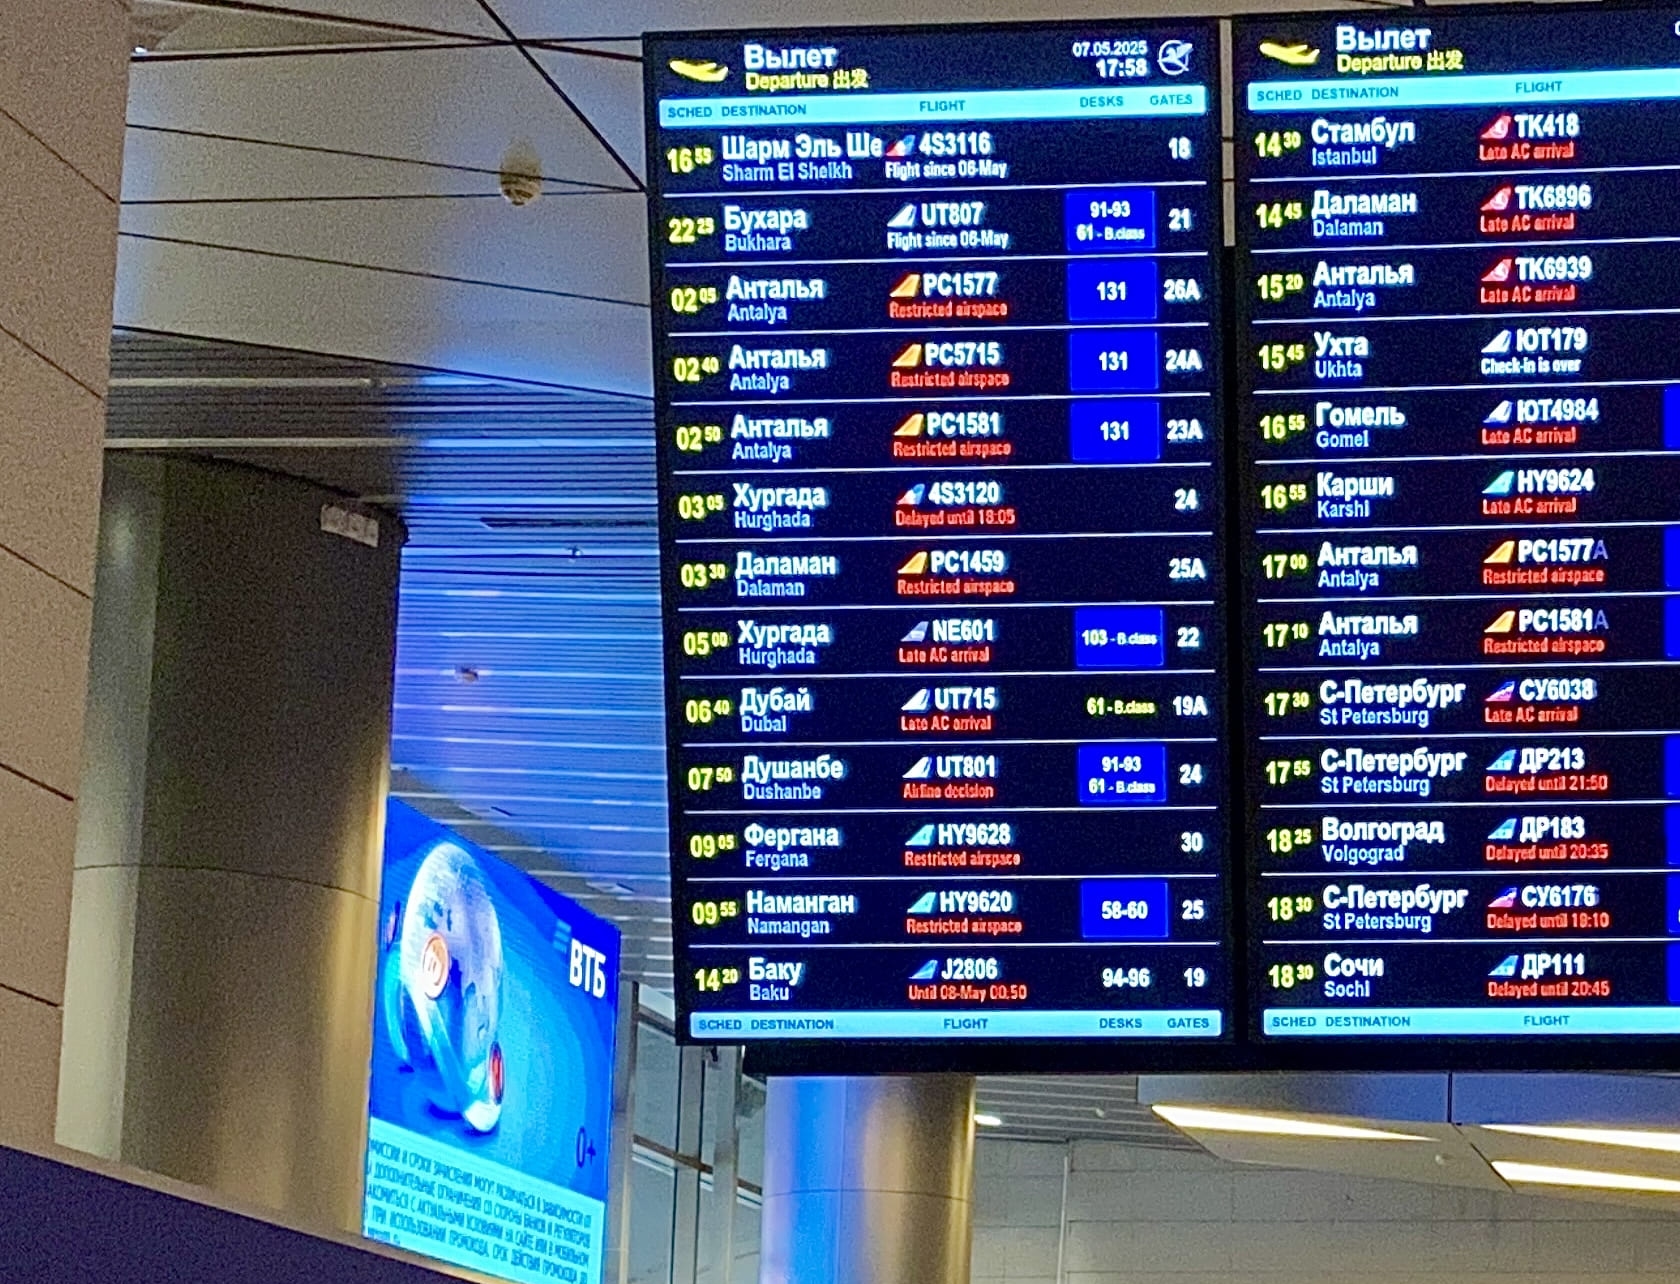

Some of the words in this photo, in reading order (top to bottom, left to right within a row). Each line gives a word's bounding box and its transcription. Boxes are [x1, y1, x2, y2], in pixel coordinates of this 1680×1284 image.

[744, 44, 836, 70] Вылет
[1072, 41, 1148, 57] 07.05.2025
[1097, 58, 1148, 77] 17:58
[746, 73, 828, 90] Departure
[833, 71, 868, 88] 出发
[668, 106, 712, 118] SCHED
[722, 104, 806, 117] DESTINATION
[920, 101, 965, 112] FLIGHT
[1079, 95, 1123, 108] DESKS
[1150, 94, 1193, 106] GATES
[1311, 119, 1415, 145] Стамбул
[1515, 114, 1578, 138] TK418
[722, 137, 788, 161] Шарм
[795, 135, 840, 157] Эль
[846, 133, 882, 156] Ше
[919, 133, 991, 155] 4S3116
[1170, 138, 1190, 158] 18
[1312, 146, 1377, 166] Istanbul
[723, 163, 771, 182] Sharm
[778, 163, 792, 179] El
[798, 162, 852, 180] Sheikh
[724, 207, 807, 235] Бухара
[921, 203, 983, 225] UT807
[1169, 209, 1191, 229] 21
[725, 234, 791, 251] Bukhara
[888, 232, 920, 249] Flight
[924, 232, 956, 248] since
[961, 231, 1008, 249] 06-May
[726, 278, 824, 300] Анталья
[1097, 283, 1127, 300] 131
[728, 305, 787, 323] Antalya
[1314, 332, 1368, 357] Ухта
[1516, 328, 1587, 353] ЮТ179
[1315, 359, 1362, 378] Ukhta
[1482, 357, 1534, 374] Check-in
[1538, 357, 1548, 373] is
[1552, 357, 1581, 373] over
[1316, 403, 1405, 427] Гомель
[1317, 430, 1368, 448] Gomel
[1320, 680, 1466, 707] С-Петербург
[1320, 708, 1338, 724] St
[1341, 706, 1429, 726] Petersburg
[742, 758, 843, 781] Душанбе
[936, 756, 995, 777] UT801
[1180, 765, 1202, 785] 24
[744, 783, 821, 800] Dushanbe
[1322, 818, 1444, 846] Волгоград
[1520, 818, 1584, 841] ДР183
[1323, 846, 1404, 864] Volgograd
[747, 892, 855, 915] Наманган
[940, 892, 1012, 913] HY9620
[1102, 901, 1148, 920] 58-60
[1182, 900, 1203, 920] 25
[748, 919, 829, 936] Namangan
[569, 939, 606, 998] ВТБ
[749, 958, 801, 984] Баку
[942, 958, 997, 980] J2806
[1325, 955, 1384, 978] Сочи
[750, 984, 789, 1001] Baku
[1325, 980, 1370, 998] Sochi
[576, 1127, 596, 1168] 0+
